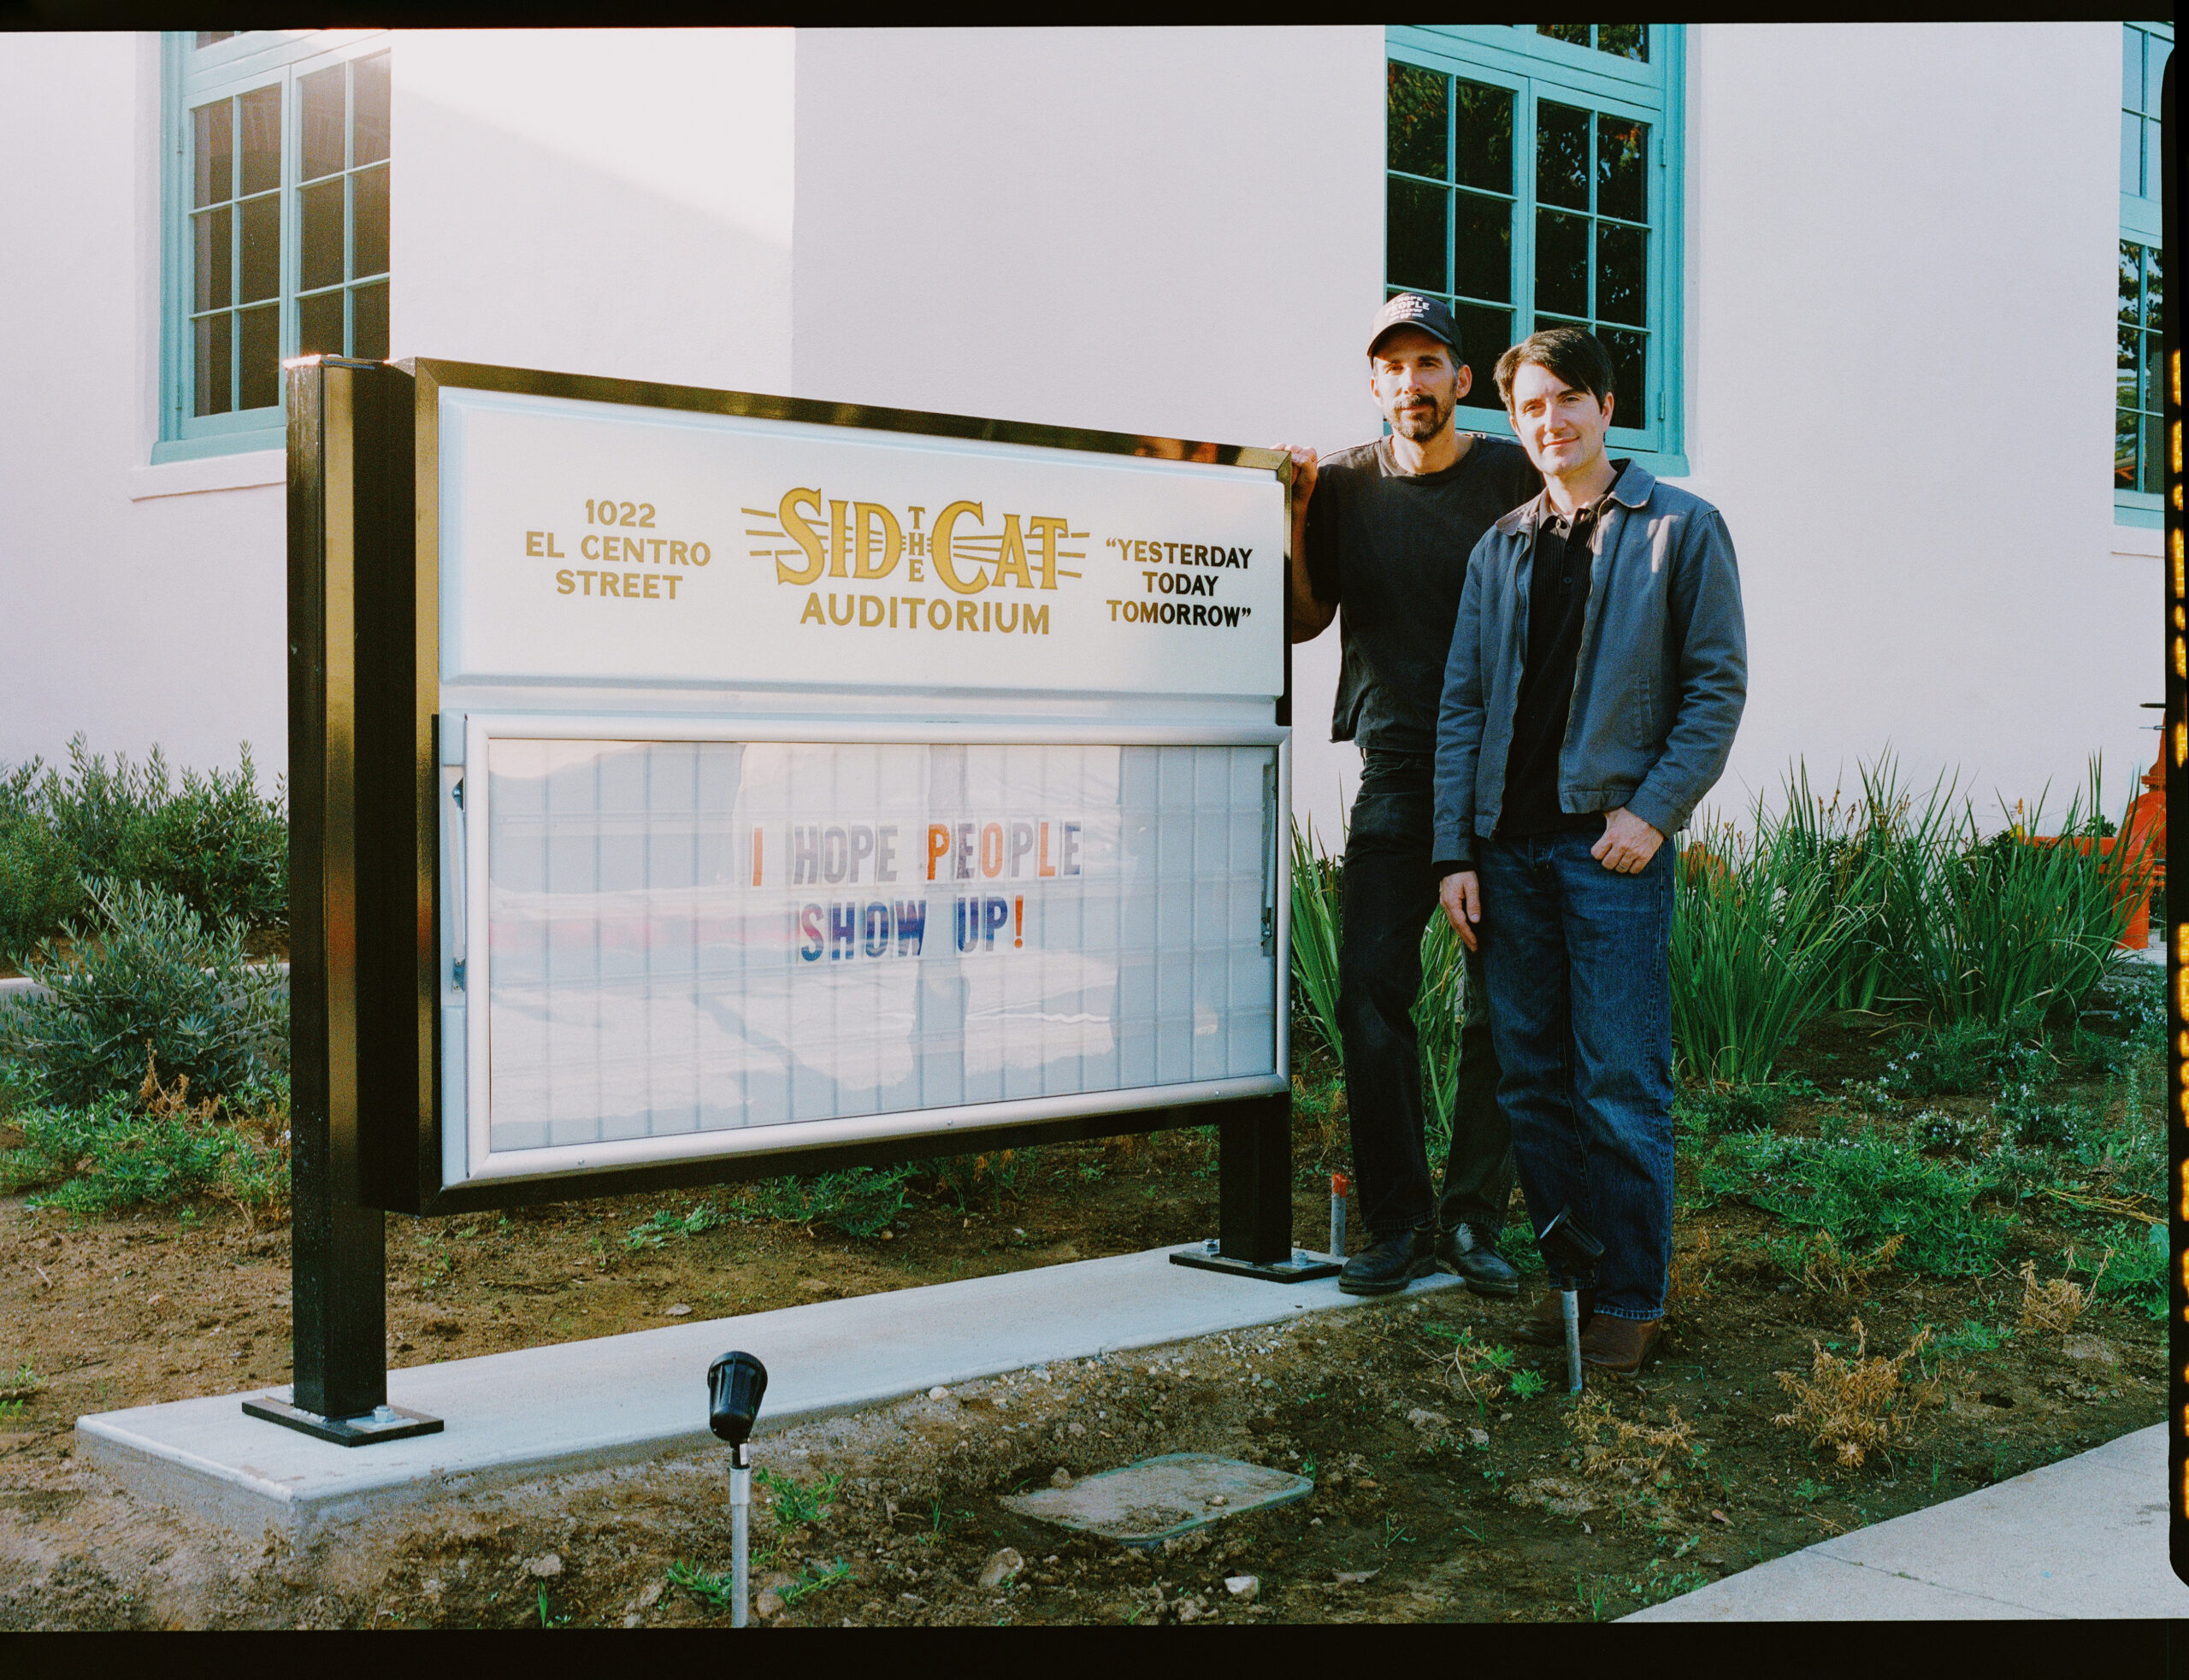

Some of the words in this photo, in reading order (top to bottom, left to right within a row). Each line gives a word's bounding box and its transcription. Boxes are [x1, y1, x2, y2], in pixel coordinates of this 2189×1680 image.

[585, 498, 656, 528] 1022
[525, 531, 565, 558] EL
[580, 534, 711, 567] CENTRO
[775, 486, 903, 586] SID
[907, 505, 926, 583] THE
[931, 500, 1069, 595] CAT
[1106, 537, 1253, 569] “YESTERDAY
[555, 569, 683, 600] STREET
[1142, 571, 1218, 597] TODAY
[799, 592, 1050, 635] AUDITORIUM
[1106, 600, 1252, 628] TOMORROW”
[752, 827, 764, 887] I
[793, 825, 899, 885] HOPE
[926, 821, 1082, 881] PEOPLE
[800, 899, 927, 962] SHOW
[957, 894, 1024, 953] UP!
